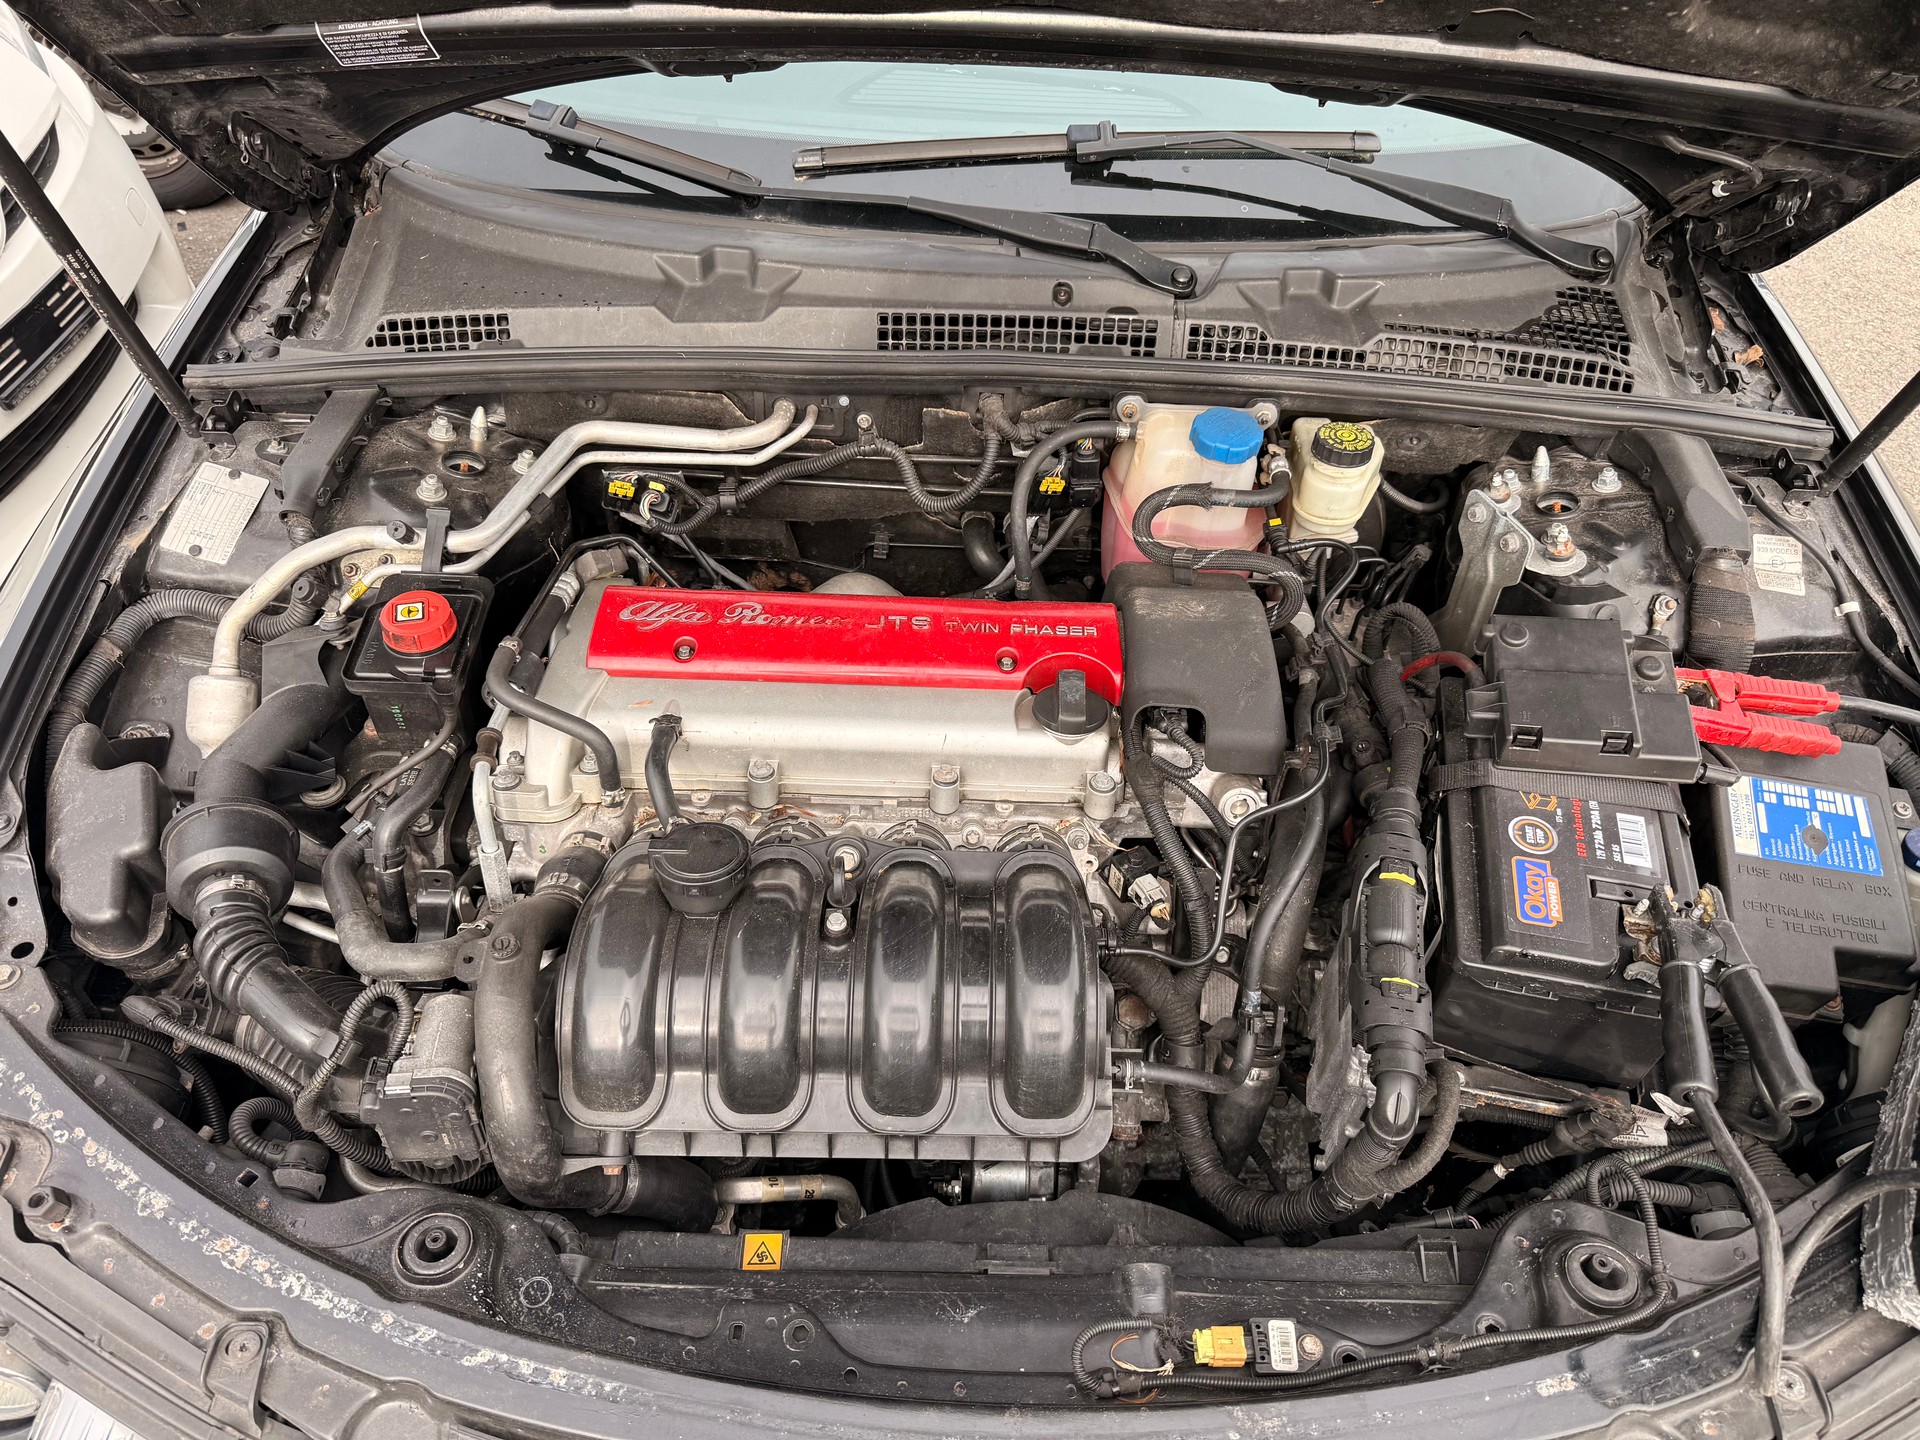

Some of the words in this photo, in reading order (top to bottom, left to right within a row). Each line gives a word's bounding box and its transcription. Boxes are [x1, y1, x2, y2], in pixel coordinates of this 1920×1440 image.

[338, 22, 368, 30] ATTENTION
[372, 18, 398, 26] ACHTUNG
[619, 600, 713, 631] Alfa
[864, 615, 930, 630] JTS
[944, 620, 1000, 634] TWIN
[1010, 623, 1098, 637] PHASER
[1590, 809, 1603, 830] 720A
[1525, 825, 1535, 844] START
[1536, 829, 1545, 844] STOP
[1577, 842, 1587, 858] EFB
[1523, 863, 1547, 918] Okay
[1738, 863, 1772, 878] FUSE
[1779, 871, 1804, 883] AND
[1812, 876, 1854, 891] RELAY
[1865, 884, 1893, 897] BOX
[1547, 881, 1559, 917] POWER
[1743, 899, 1825, 921] CENTRALINA
[1833, 913, 1888, 931] FUSIBILI
[1766, 917, 1775, 928] E
[1783, 920, 1879, 945] TELERUTTORI
[768, 1177, 778, 1188] 10
